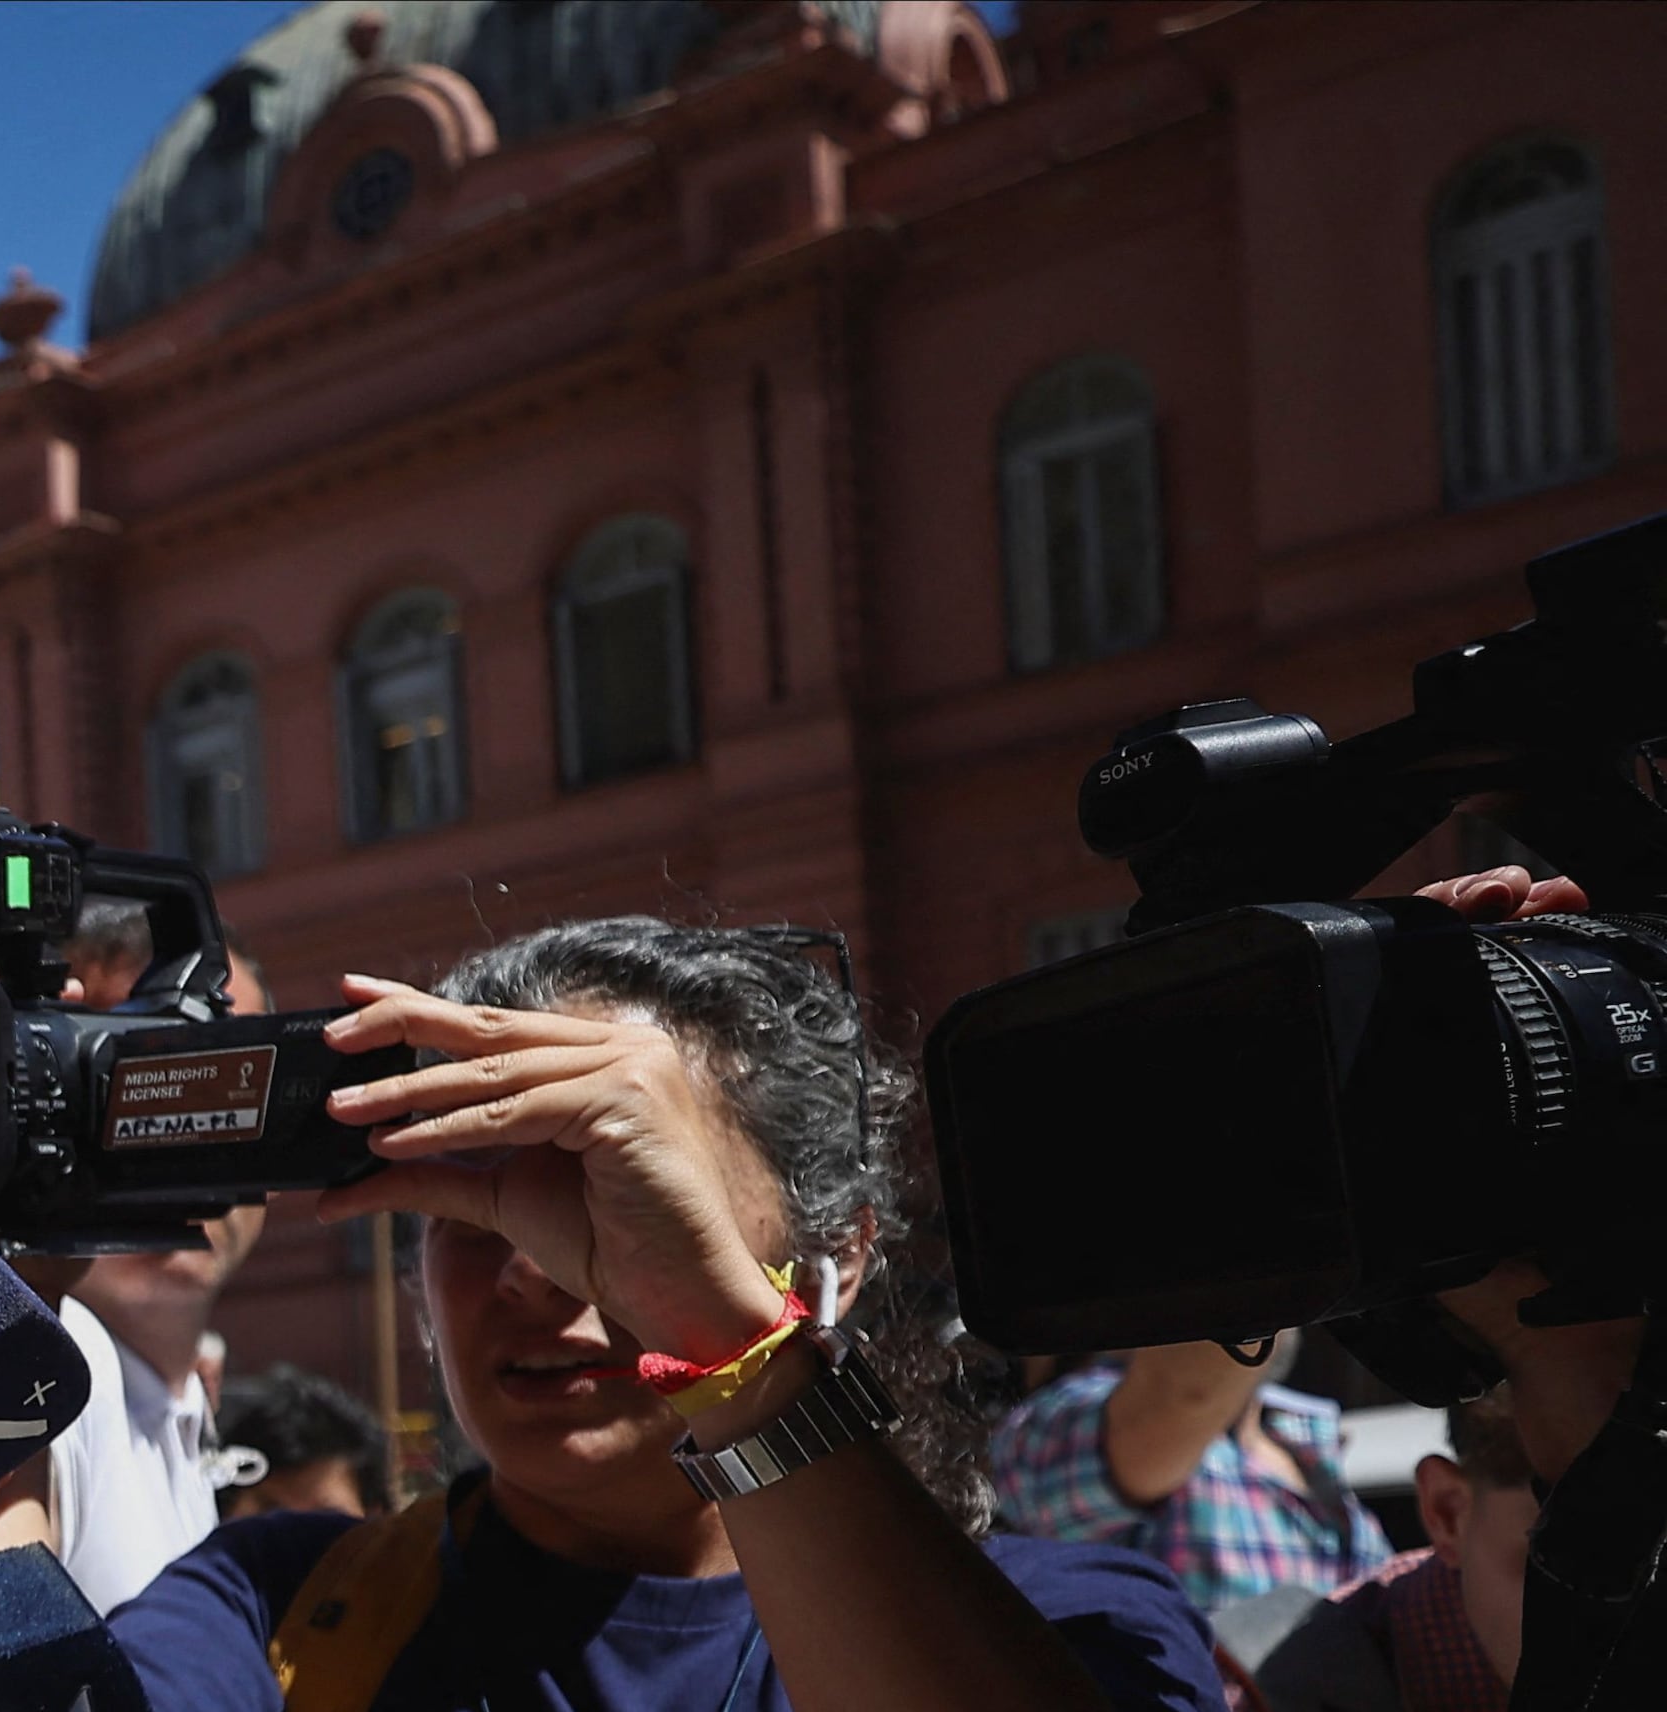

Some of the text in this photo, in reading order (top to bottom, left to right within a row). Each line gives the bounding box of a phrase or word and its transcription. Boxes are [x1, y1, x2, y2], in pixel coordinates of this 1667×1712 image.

[1098, 751, 1155, 785] SONY
[124, 1066, 218, 1087] MEDIA RIGHTS
[122, 1085, 184, 1103] LICENSEE
